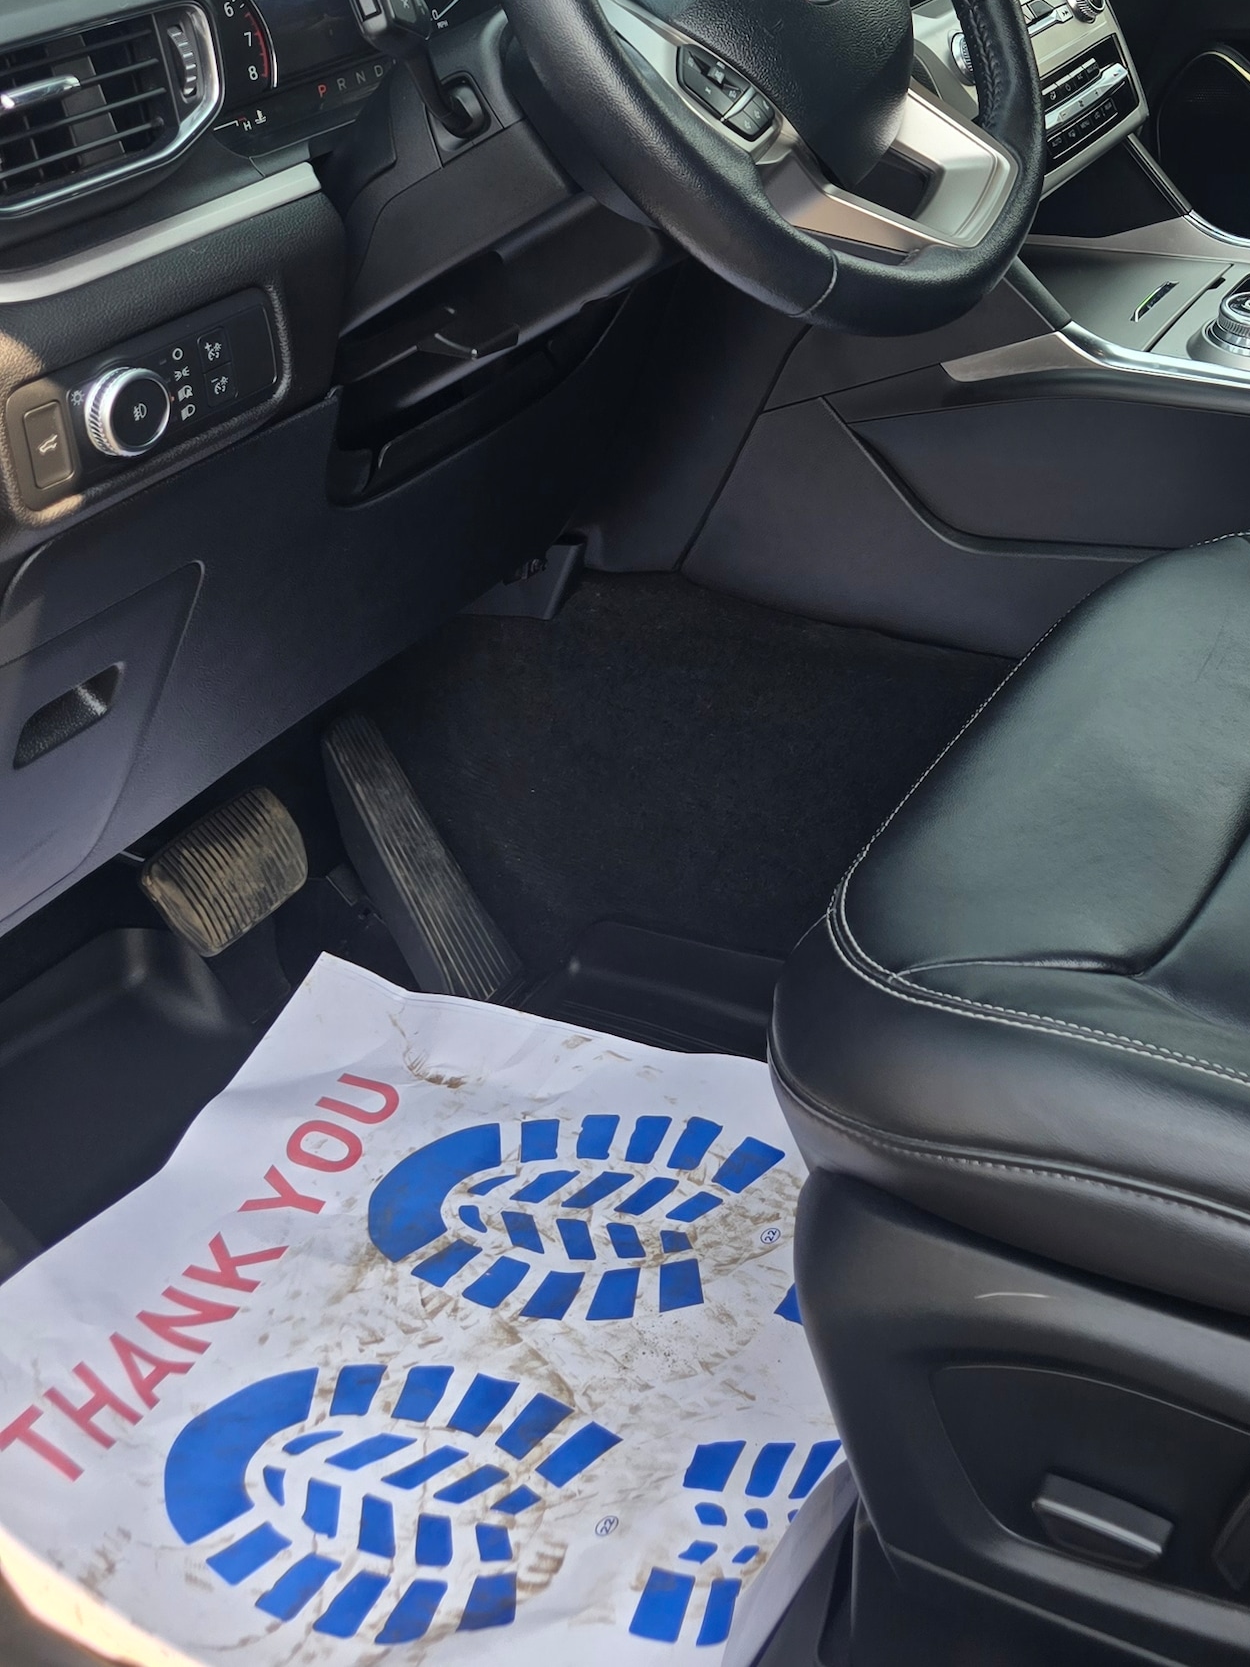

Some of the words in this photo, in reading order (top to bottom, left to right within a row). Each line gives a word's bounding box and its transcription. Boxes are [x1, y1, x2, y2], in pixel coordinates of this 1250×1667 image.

[223, 1, 234, 17] 6
[243, 31, 252, 47] 7
[248, 65, 259, 80] 8
[317, 84, 327, 98] P
[336, 77, 347, 91] R
[355, 70, 366, 84] N
[373, 64, 384, 78] D
[243, 120, 252, 131] H
[0, 1231, 288, 1482] THANK
[239, 1072, 400, 1216] YOU
